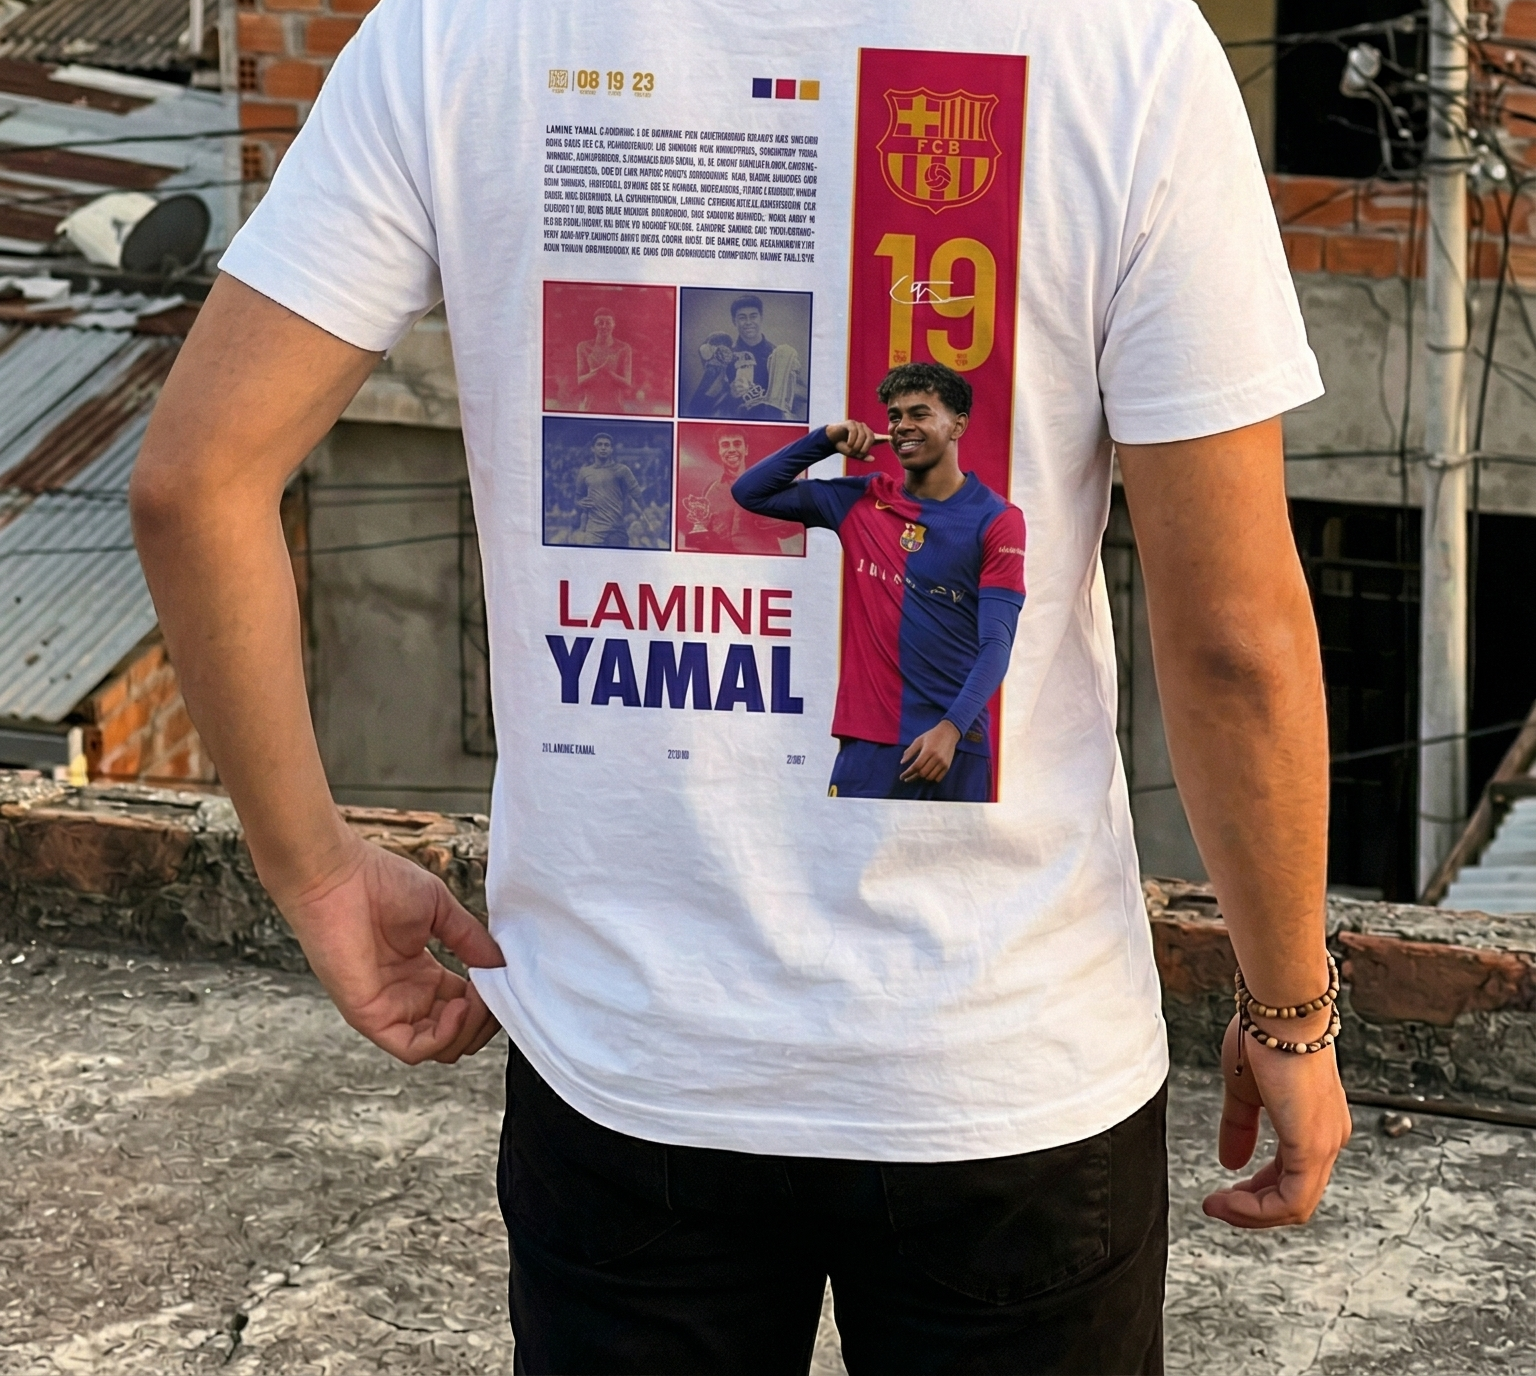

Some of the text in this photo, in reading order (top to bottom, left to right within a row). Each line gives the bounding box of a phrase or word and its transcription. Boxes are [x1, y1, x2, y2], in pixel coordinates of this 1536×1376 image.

[577, 70, 654, 91] 08 19 23
[546, 125, 597, 135] LAMINE YAMAL
[873, 233, 996, 372] 19
[560, 580, 792, 637] LAMINE
[545, 634, 804, 714] YAMAL
